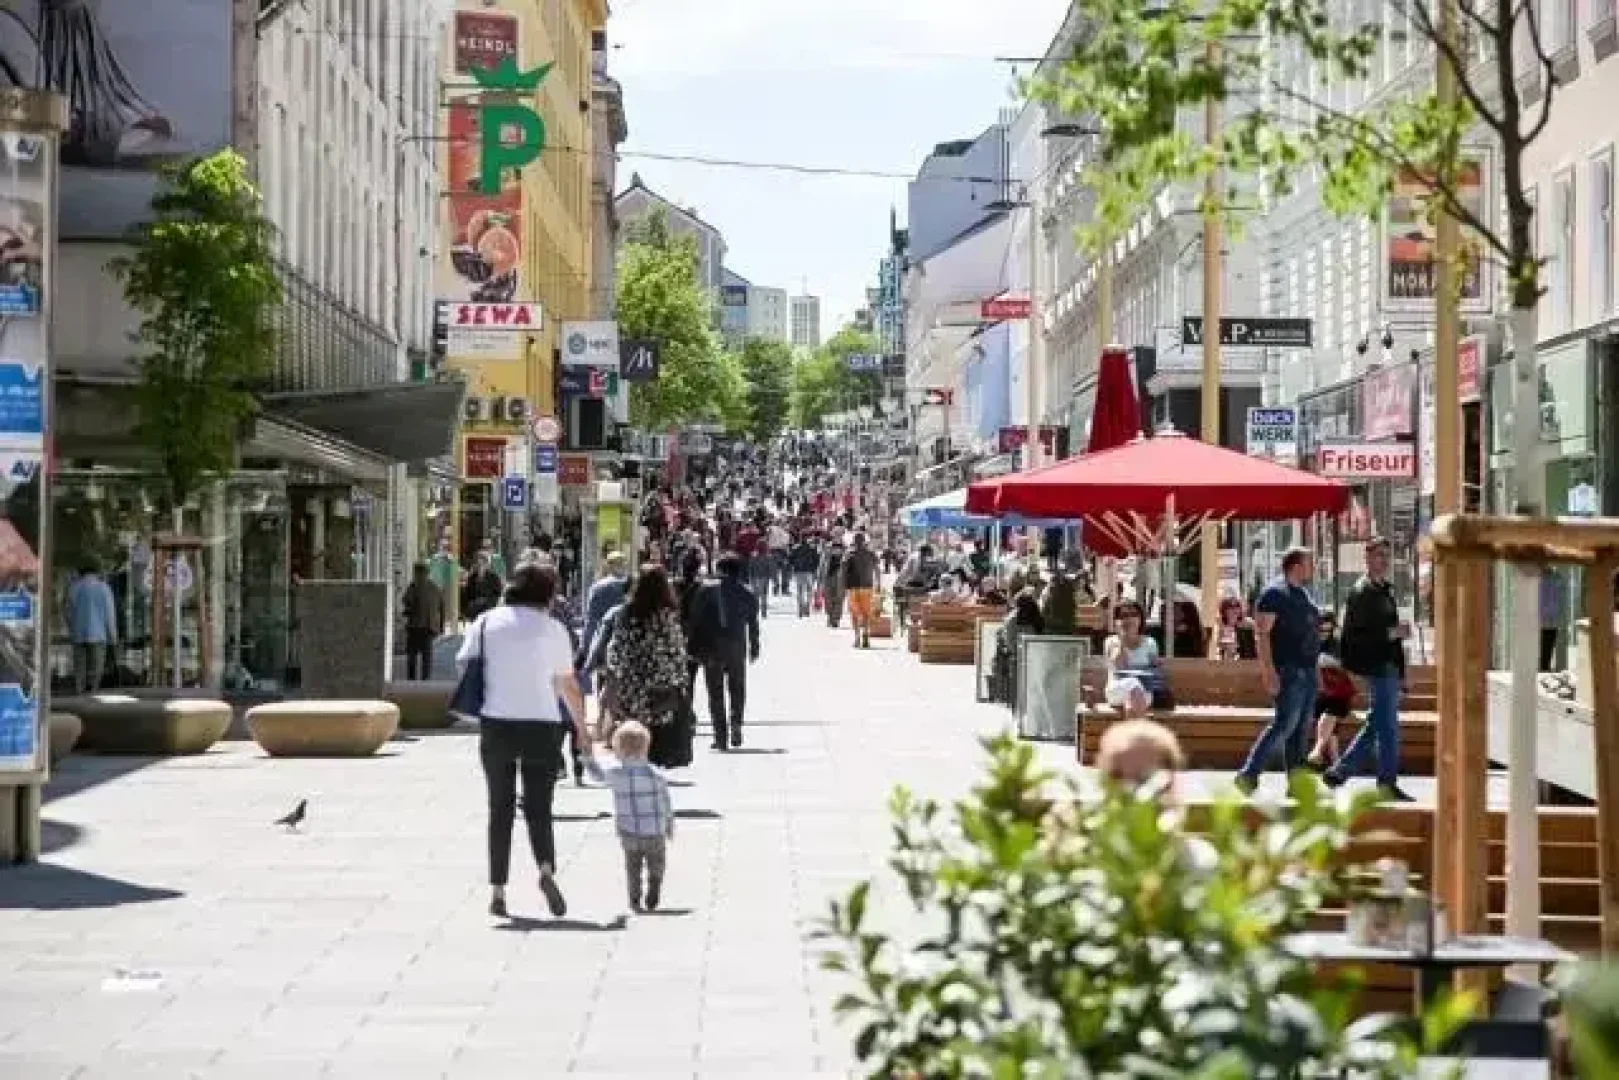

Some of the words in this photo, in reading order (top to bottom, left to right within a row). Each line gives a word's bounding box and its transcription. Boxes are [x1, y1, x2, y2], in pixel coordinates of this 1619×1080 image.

[456, 305, 532, 325] SEWA
[1252, 427, 1293, 441] WERK
[1323, 450, 1411, 471] Friseur
